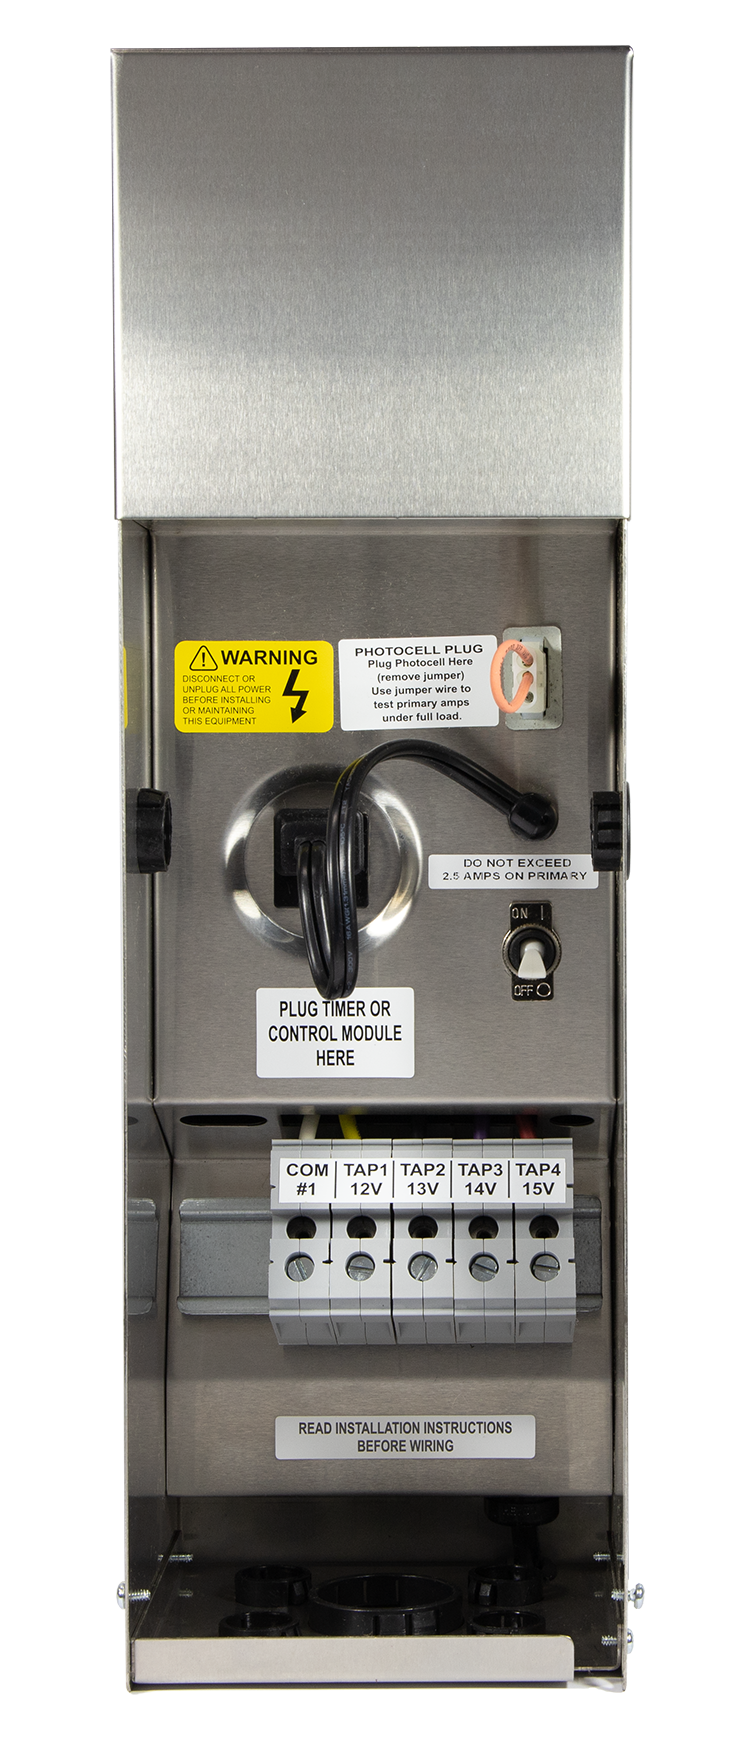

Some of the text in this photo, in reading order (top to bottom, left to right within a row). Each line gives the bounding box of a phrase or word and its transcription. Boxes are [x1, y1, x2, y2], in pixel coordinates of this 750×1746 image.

[356, 644, 482, 656] PHOTOCELL PLUG
[221, 650, 317, 665] WARNING
[367, 657, 474, 670] Plug Photocell Here
[182, 674, 256, 683] DISCONNECT OR
[377, 671, 464, 684] (remove jumper)
[182, 685, 272, 694] UNPLUG ALL POWER
[371, 684, 472, 697] Use jumper wire to
[182, 695, 271, 704] BEFORE INSTALLING
[373, 699, 470, 710] test primary amps
[182, 706, 255, 715] OR MAINTAINING
[182, 716, 256, 726] THIS EQUIPMENT
[382, 711, 462, 723] under full load.
[463, 858, 572, 868] DO NOT EXCEED
[442, 871, 587, 881] 2.5 AMPS ON PRIMARY
[512, 908, 527, 918] ON
[514, 985, 533, 996] OFF
[280, 1001, 390, 1017] PLUG TIMER OR
[269, 1025, 401, 1041] CONTROL MODULE
[317, 1050, 354, 1065] HERE
[287, 1164, 328, 1176] COM
[344, 1164, 386, 1176] TAP1
[400, 1164, 445, 1176] TAP2
[458, 1164, 502, 1176] TAP3
[516, 1163, 561, 1176] TAP4
[297, 1183, 314, 1195] #1
[351, 1183, 382, 1195] 12V
[408, 1183, 439, 1195] 13V
[465, 1183, 496, 1195] 14V
[523, 1182, 554, 1195] 15V
[299, 1421, 512, 1434] READ INSTALLATION INSTRUCTIONS
[358, 1440, 453, 1452] BEFORE WIRING
